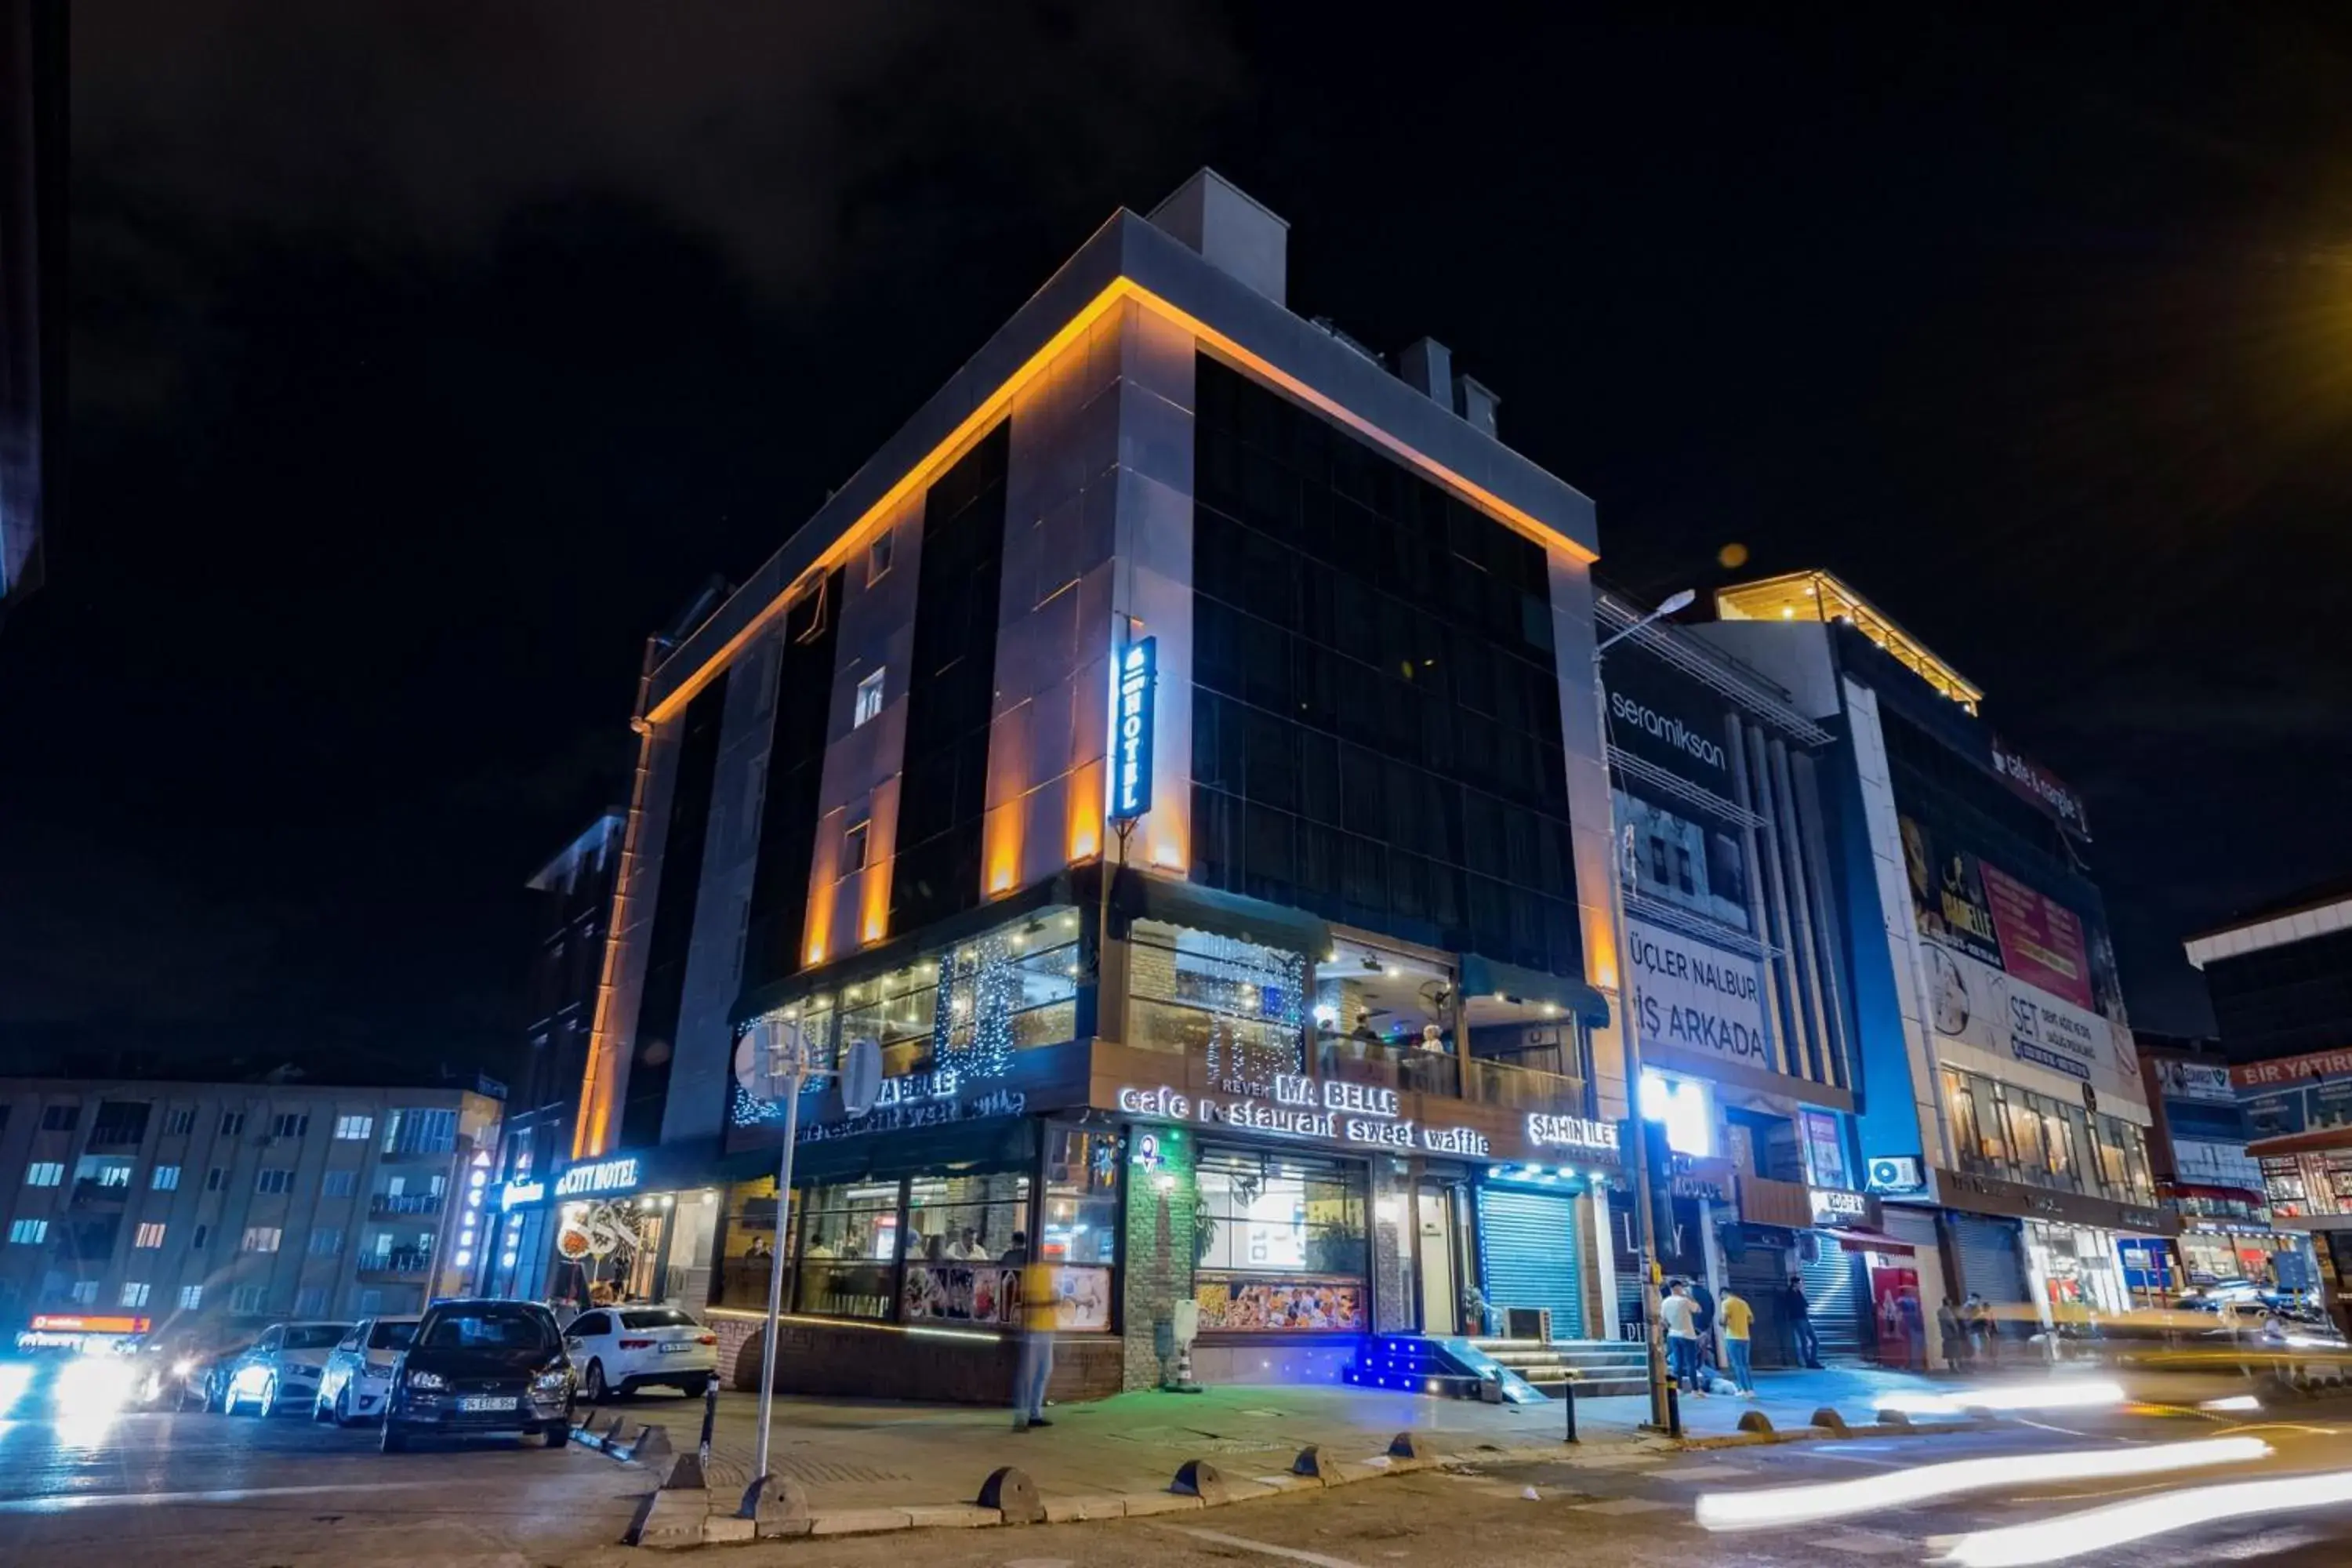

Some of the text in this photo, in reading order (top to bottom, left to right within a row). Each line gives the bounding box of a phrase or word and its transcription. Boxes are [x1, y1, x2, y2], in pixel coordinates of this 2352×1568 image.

[1630, 931, 1759, 1004] ÜÇLER NALBUR
[1669, 1004, 1766, 1062] ARKADA
[1324, 1080, 1401, 1117] BELLE
[1347, 1118, 1417, 1148] sweet
[1425, 1127, 1491, 1157] waffle
